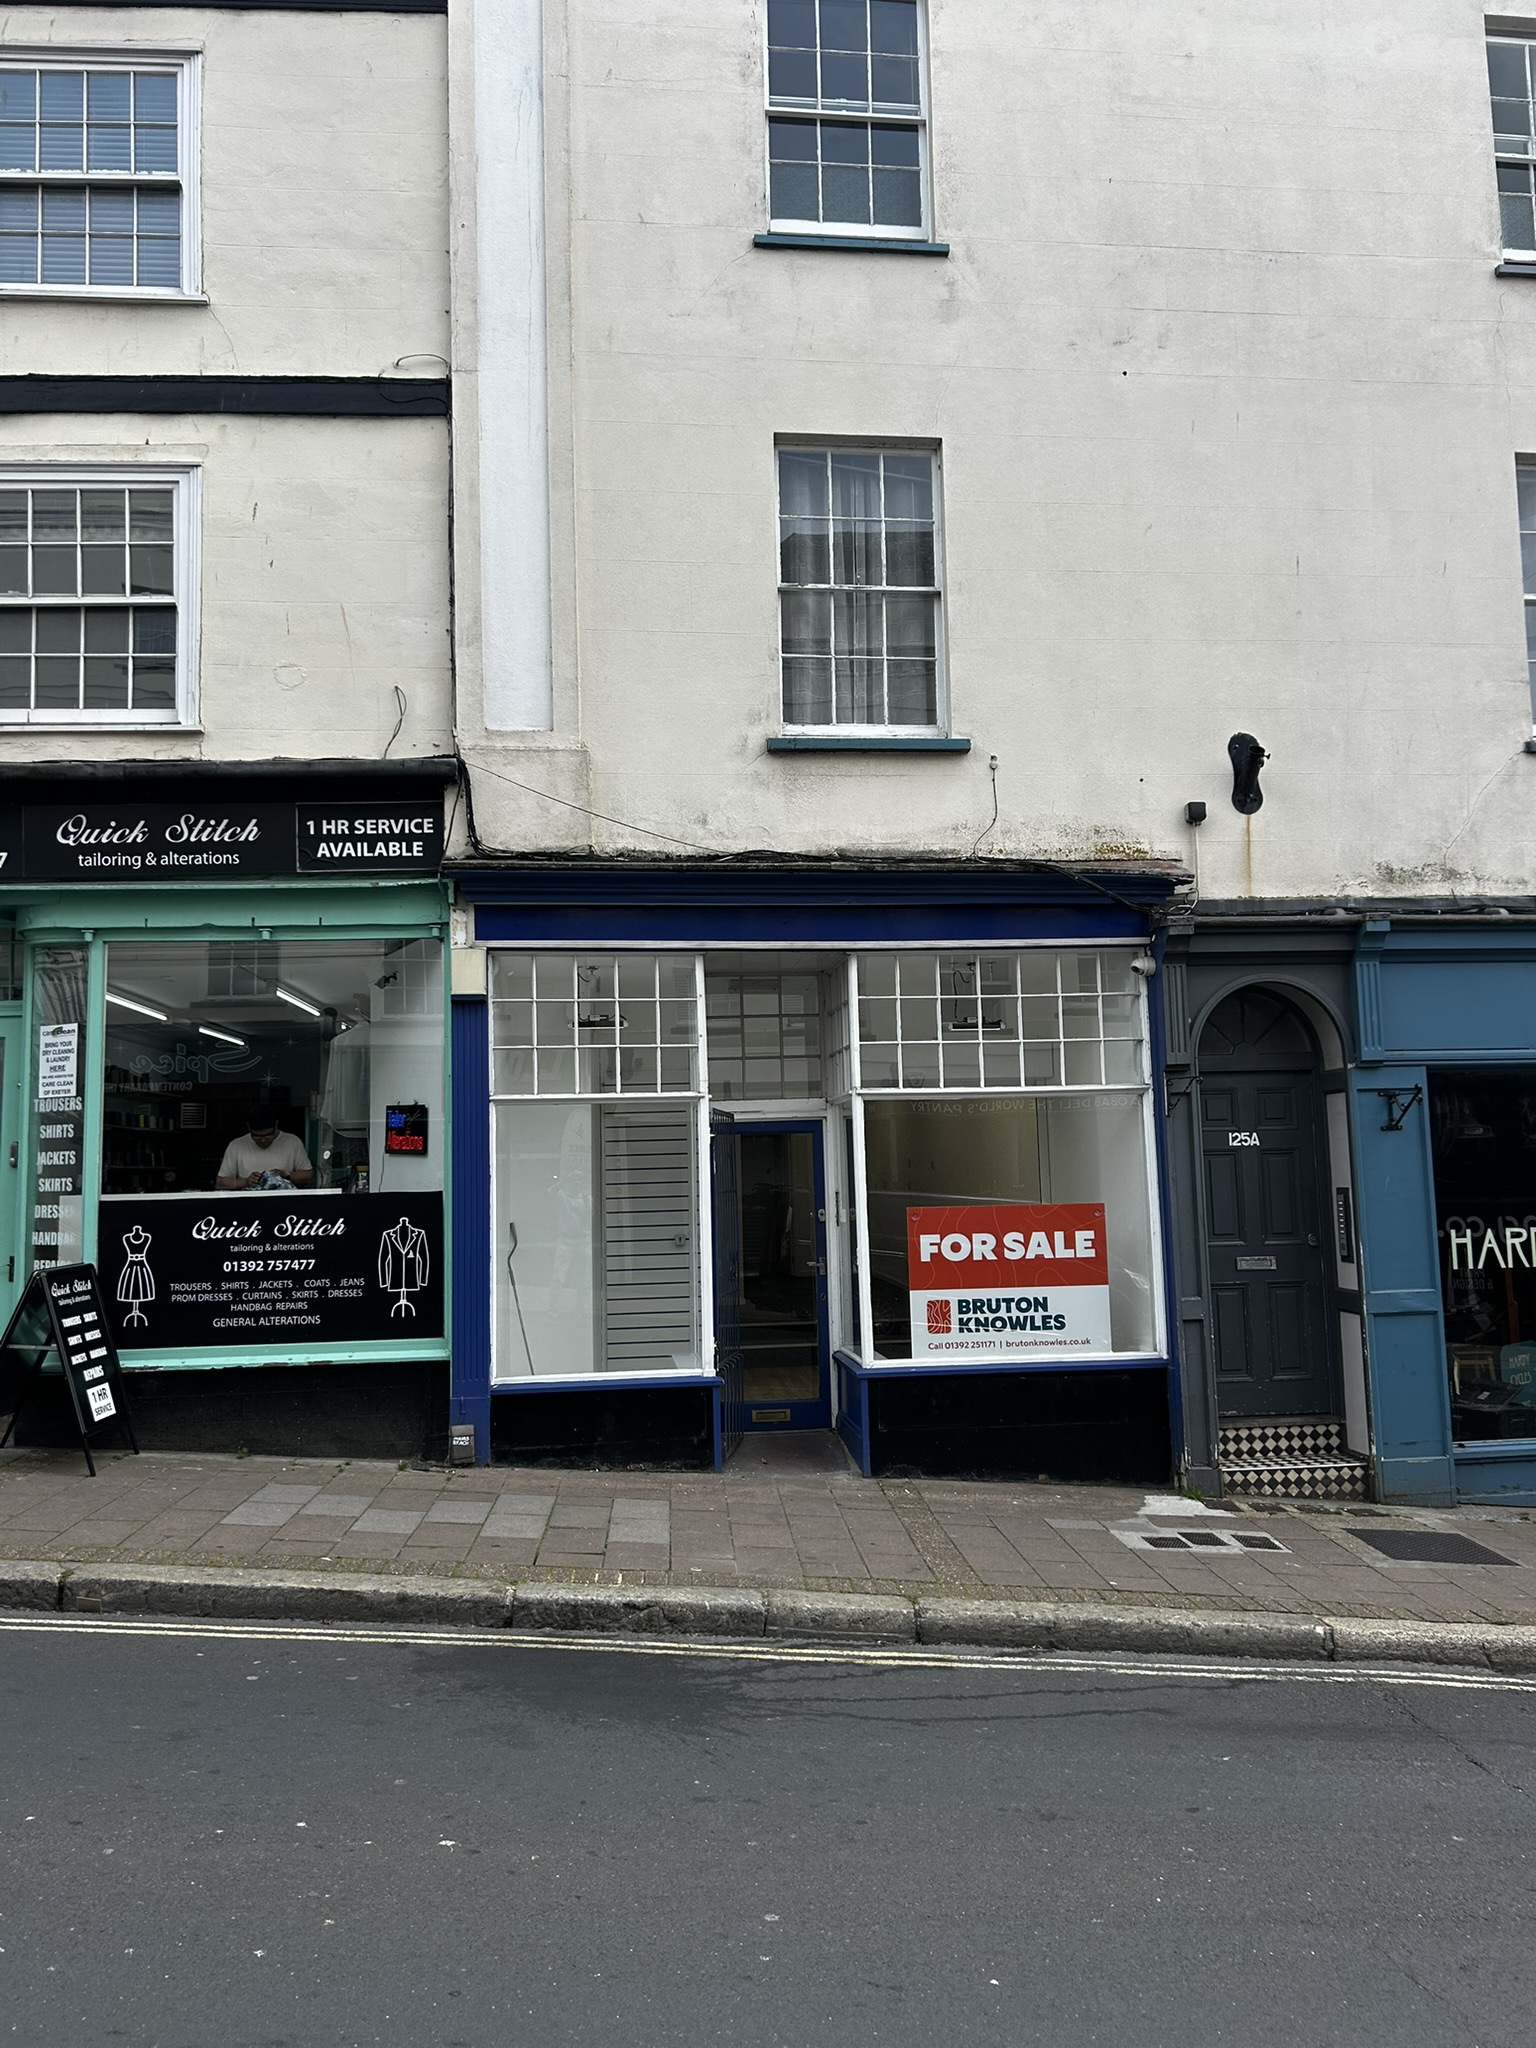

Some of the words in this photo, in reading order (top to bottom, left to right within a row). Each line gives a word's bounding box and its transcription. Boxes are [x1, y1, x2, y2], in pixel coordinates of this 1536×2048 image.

[56, 814, 149, 846] Quick
[165, 813, 262, 843] Stitch
[306, 820, 315, 835] 1
[322, 819, 349, 835] HR
[354, 818, 434, 834] SERVICE
[317, 841, 424, 858] AVAILABLE
[78, 852, 141, 869] tailoring
[145, 853, 157, 866] &
[158, 850, 240, 865] alterations
[52, 1048, 75, 1056] CLEANING
[34, 1097, 82, 1113] TROUSERS
[40, 1124, 74, 1138] SHIRTS
[1228, 1132, 1260, 1147] 125A
[37, 1150, 76, 1166] JACKETS
[38, 1177, 73, 1192] SKIRTS
[192, 1216, 261, 1240] Quick
[274, 1214, 347, 1238] Stitch
[230, 1244, 263, 1254] tailoring
[265, 1243, 271, 1251] &
[272, 1242, 315, 1251] alterations
[919, 1232, 998, 1262] FOR
[1003, 1229, 1096, 1261] SALE
[223, 1261, 264, 1272] 01392
[267, 1259, 316, 1271] 757477
[51, 1282, 71, 1297] Quick
[72, 1279, 92, 1293] Stitch
[170, 1283, 212, 1292] TROUSERS
[221, 1281, 249, 1290] SHIRTS
[258, 1280, 293, 1290] JACKETS
[304, 1279, 330, 1288] COATS
[339, 1278, 365, 1287] JEANS
[171, 1293, 197, 1302] PROM
[198, 1292, 233, 1301] DRESSES
[242, 1291, 283, 1300] CURTAINS
[292, 1290, 319, 1299] SKIRTS
[328, 1289, 363, 1298] DRESSES
[230, 1303, 272, 1312] HANDBAG
[275, 1301, 308, 1311] REPAIRS
[957, 1296, 1048, 1315] BRUTON
[213, 1317, 257, 1327] GENERAL
[258, 1315, 321, 1326] ALTERATIONS
[957, 1314, 1066, 1333] KNOWLES
[928, 1341, 944, 1350] Call
[944, 1341, 971, 1349] 01392
[971, 1340, 996, 1349] 251171
[1005, 1337, 1091, 1349] brutonknowles.co.uk
[92, 1391, 97, 1403] 1
[97, 1388, 109, 1401] HR
[95, 1402, 113, 1416] SERVICE
